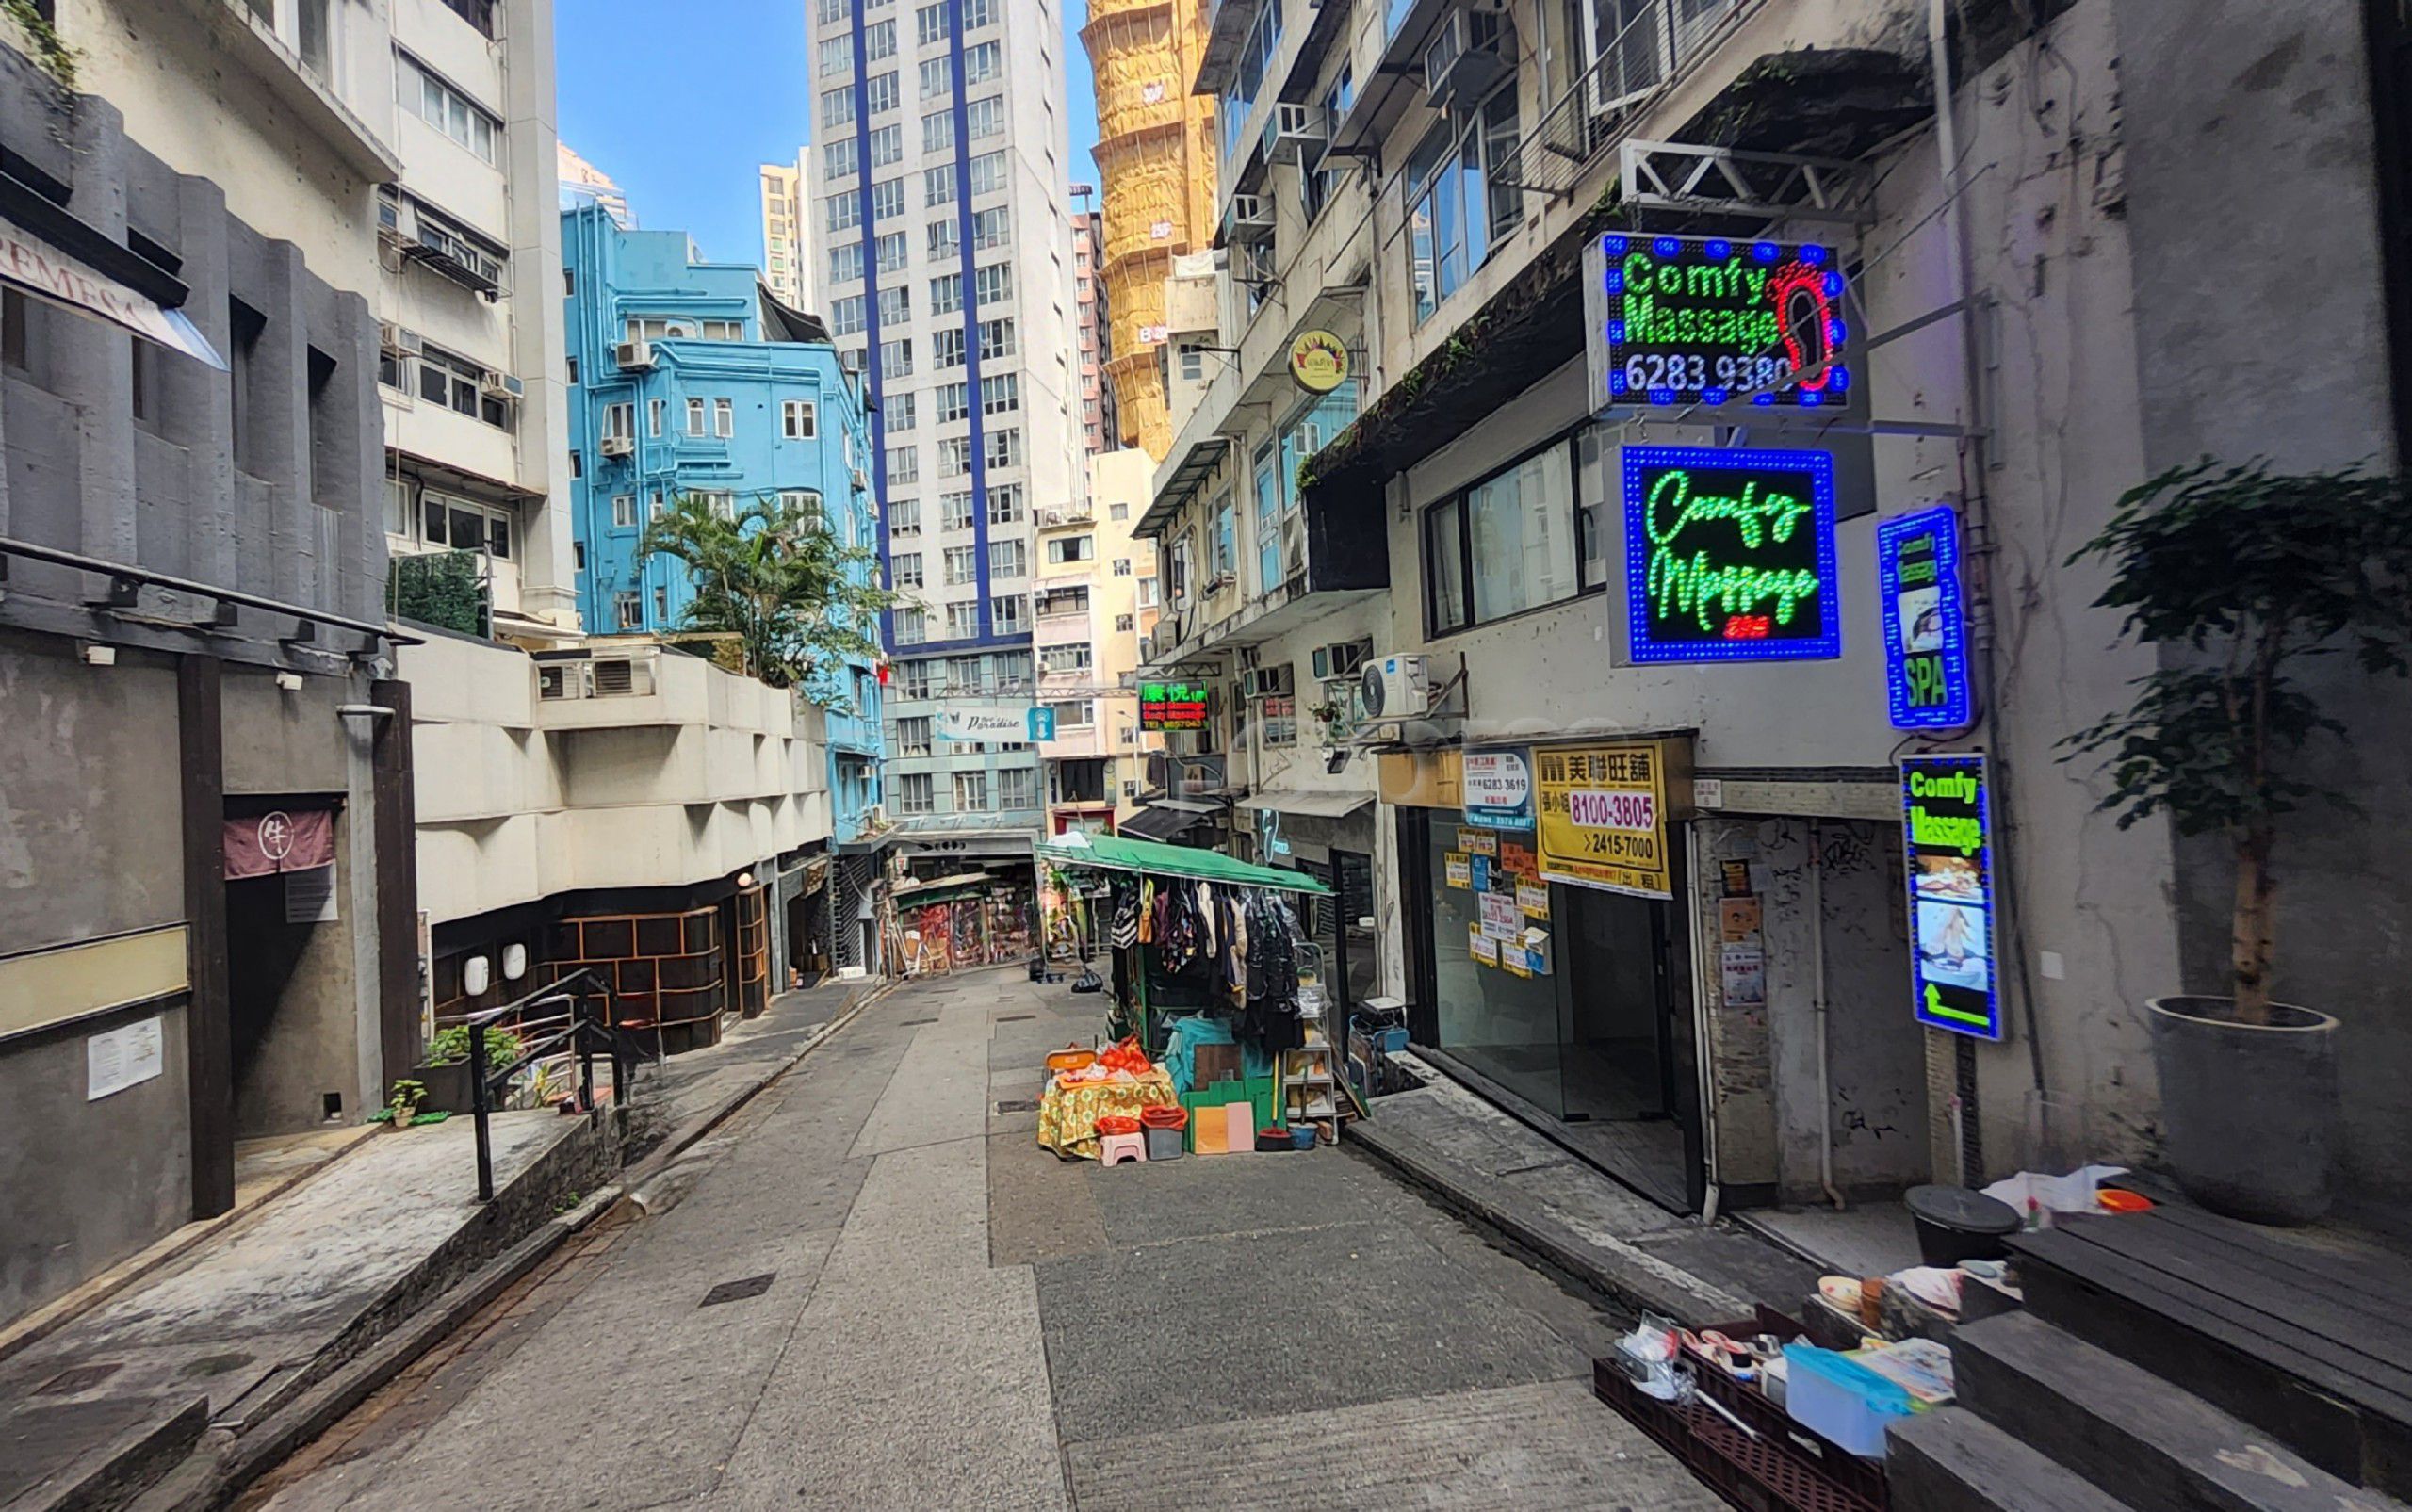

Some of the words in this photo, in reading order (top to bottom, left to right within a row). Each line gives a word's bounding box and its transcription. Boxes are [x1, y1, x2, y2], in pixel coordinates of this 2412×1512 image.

[1622, 253, 1768, 306] Comfy
[1623, 294, 1779, 354] Massage
[1625, 354, 1707, 392] 6283
[1646, 470, 1811, 549] Comfy
[1649, 547, 1819, 630] Massage
[1903, 655, 1948, 707] SPA
[967, 716, 1019, 730] Paradise
[1483, 778, 1502, 790] 6283
[1505, 778, 1526, 791] 3619
[1568, 753, 1651, 782] 美聯旺舖
[1910, 771, 1977, 804] Comfy
[1572, 794, 1653, 829] 8100-3805
[1910, 805, 1981, 856] Massage
[1592, 833, 1653, 859] 2415-7000
